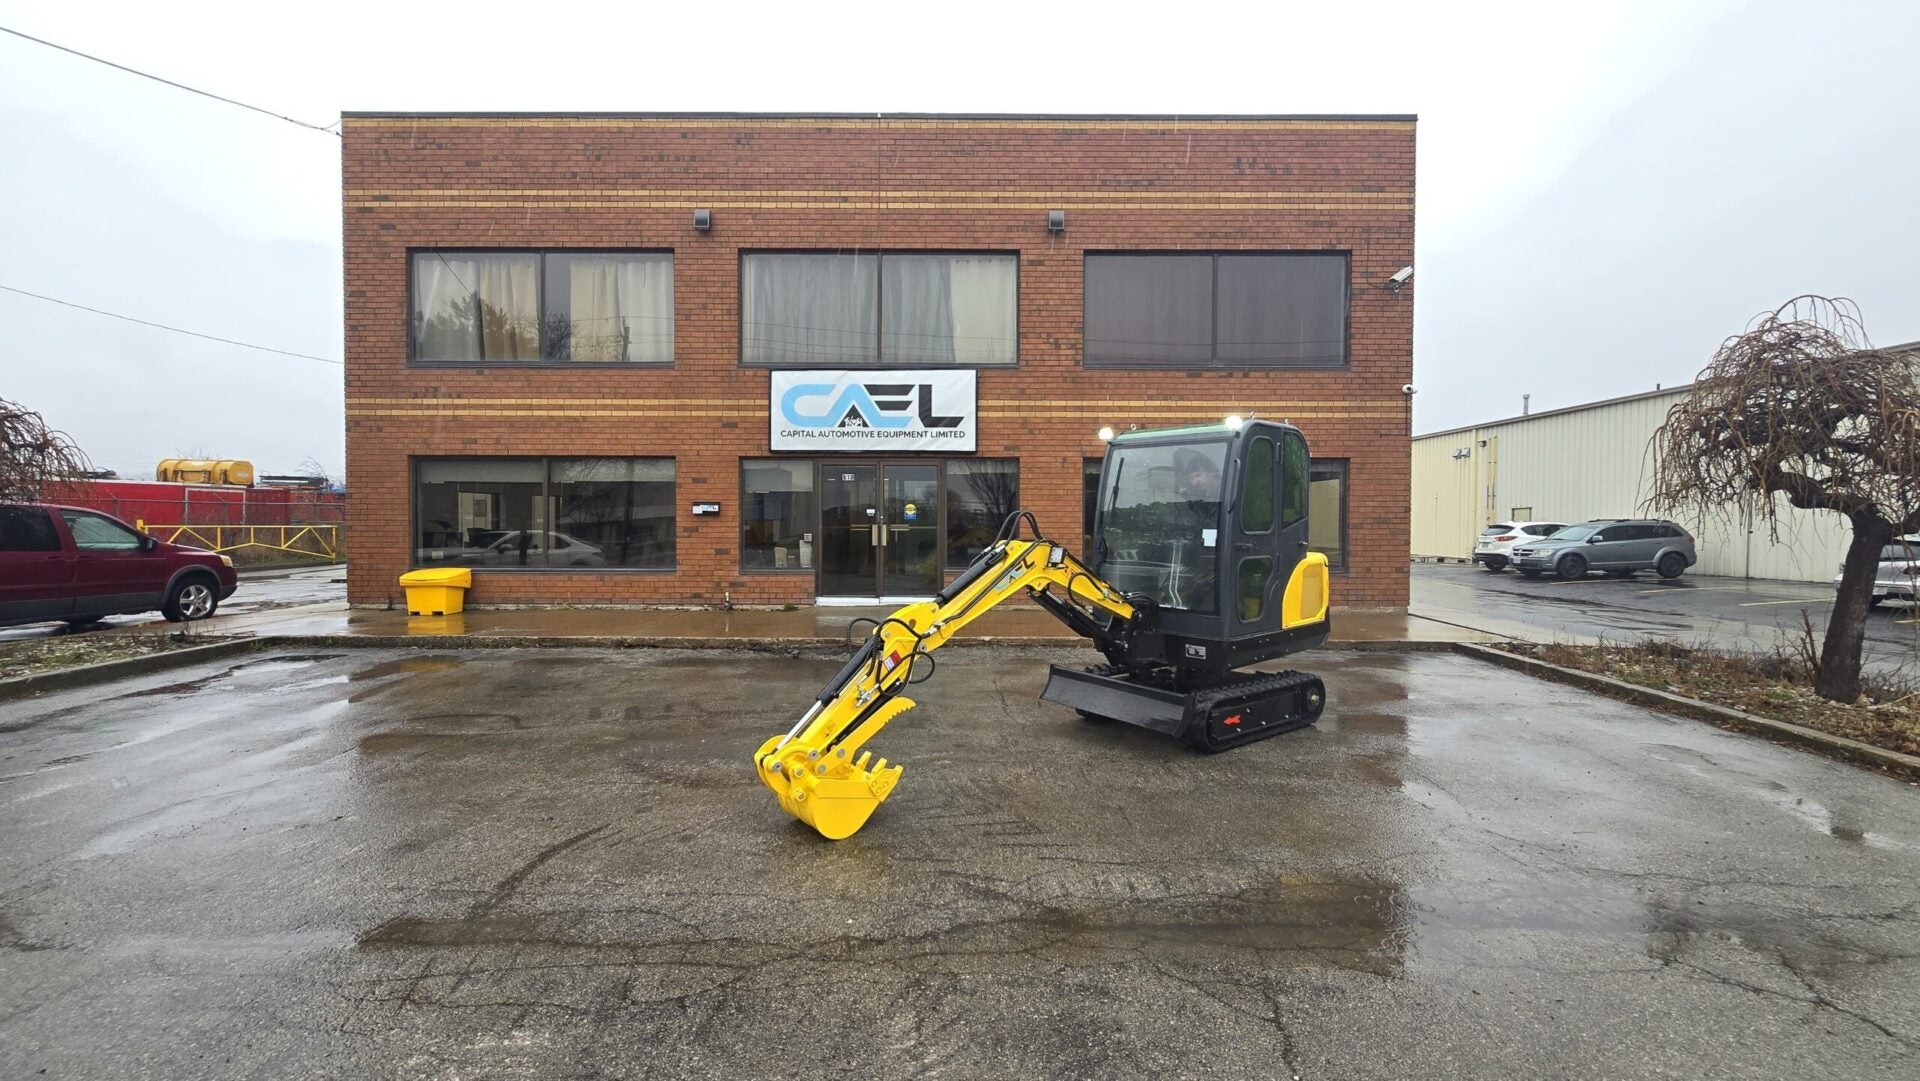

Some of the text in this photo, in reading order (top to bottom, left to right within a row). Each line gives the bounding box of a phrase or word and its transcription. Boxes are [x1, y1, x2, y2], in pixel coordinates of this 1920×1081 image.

[781, 383, 965, 428] CAEL
[780, 430, 816, 438] CAPITAL
[818, 430, 875, 438] AUTOMOTIVE
[877, 430, 928, 439] EQUIPMENT
